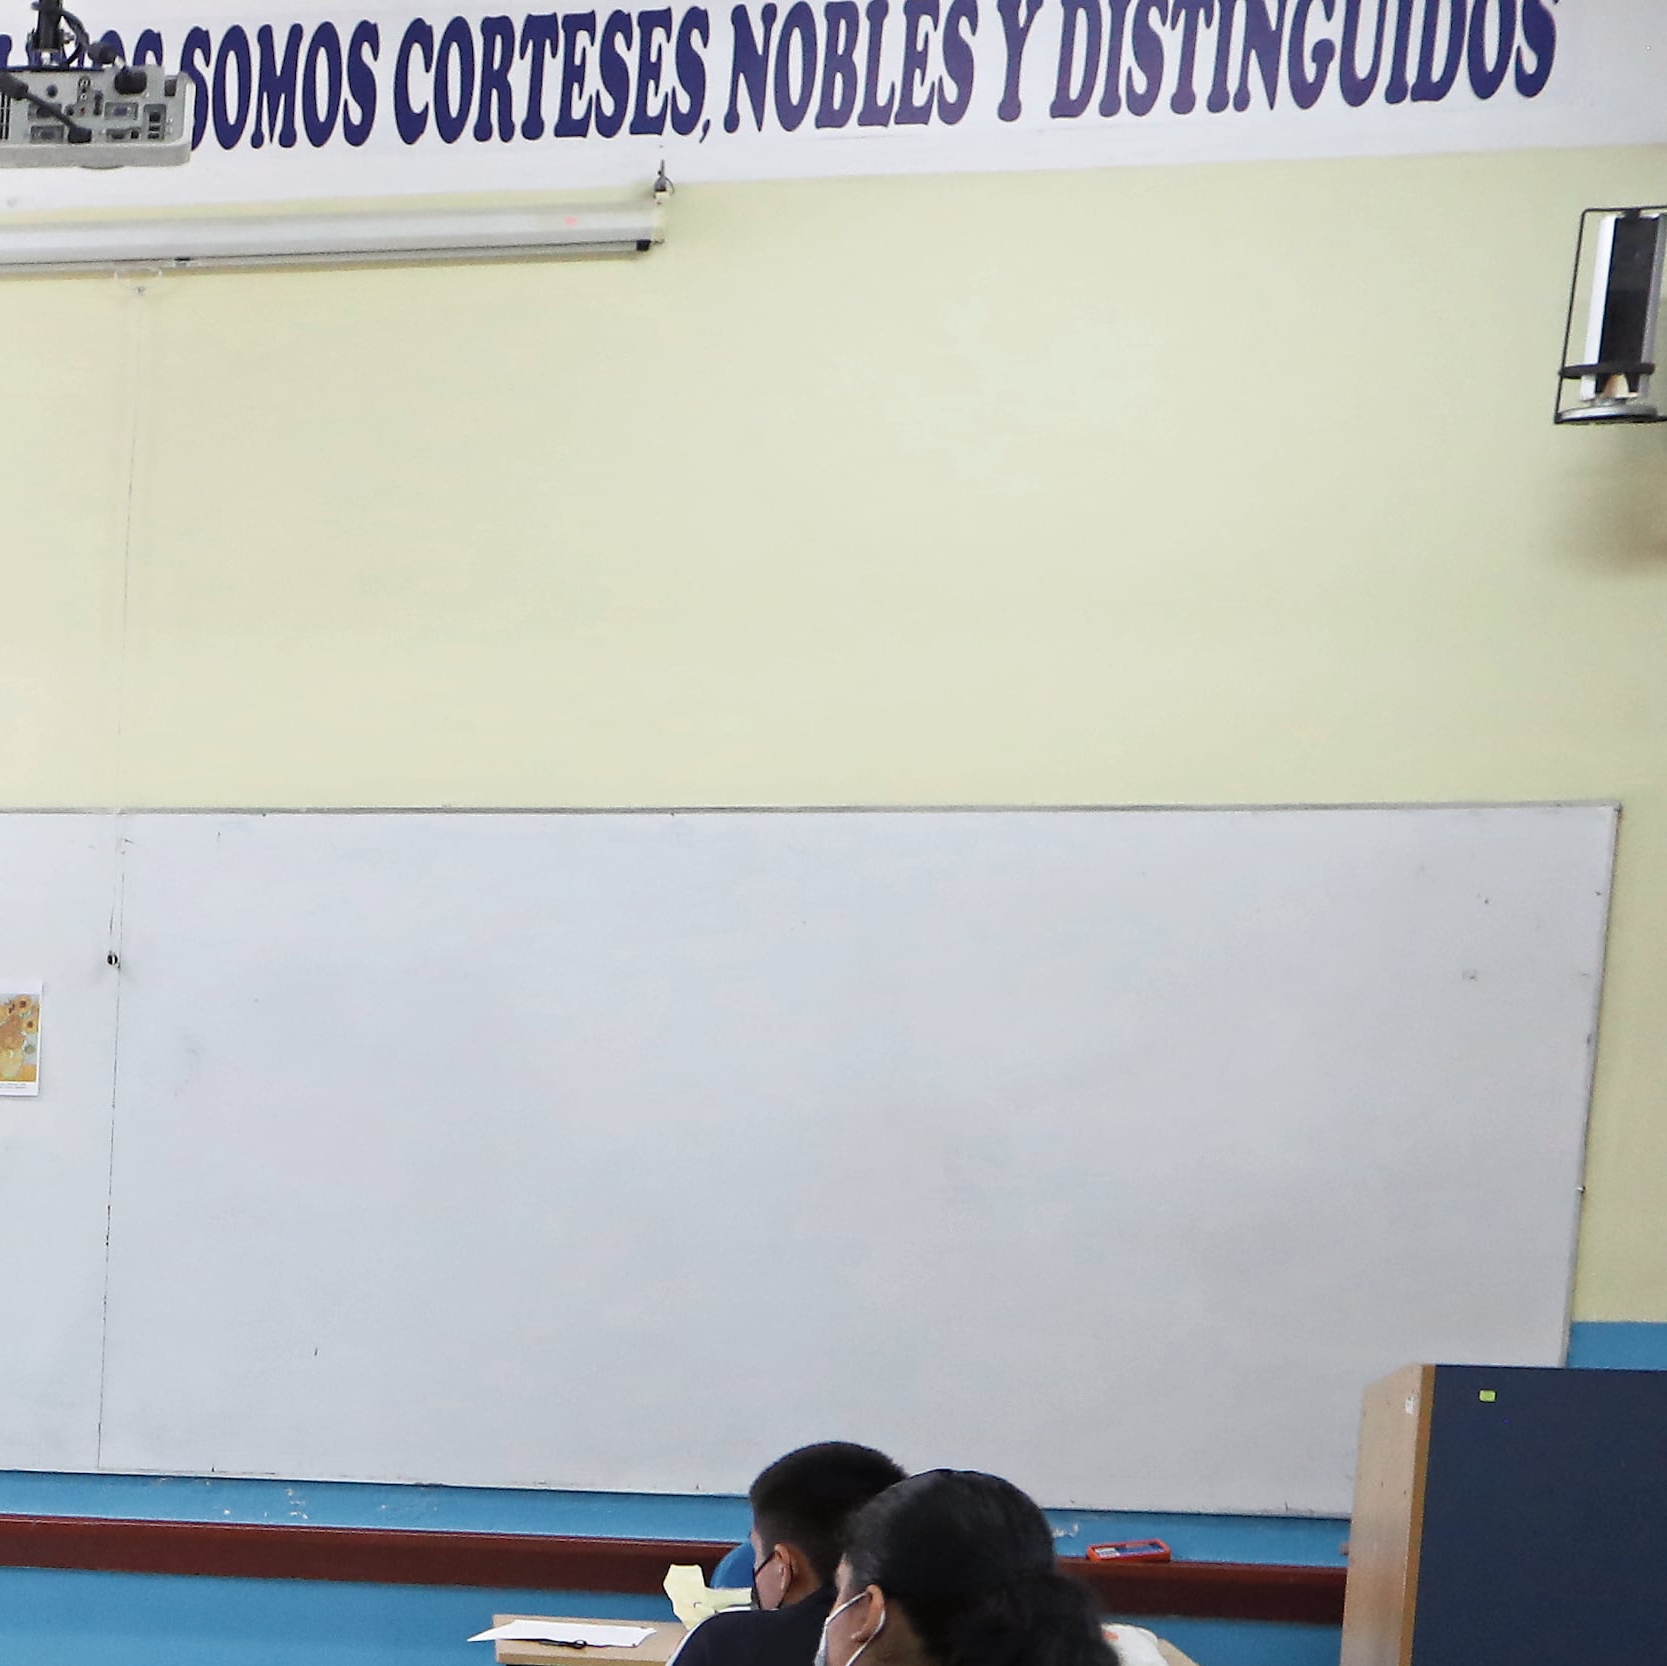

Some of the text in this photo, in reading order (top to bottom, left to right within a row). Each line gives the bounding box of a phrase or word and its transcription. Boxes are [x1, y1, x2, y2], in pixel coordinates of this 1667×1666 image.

[180, 20, 378, 151] SOMOS
[393, 6, 710, 146] CORTESES,
[723, 0, 980, 133] NOBLES
[995, 0, 1045, 122] Y
[1050, 0, 1558, 119] DISTINGUIDOS
